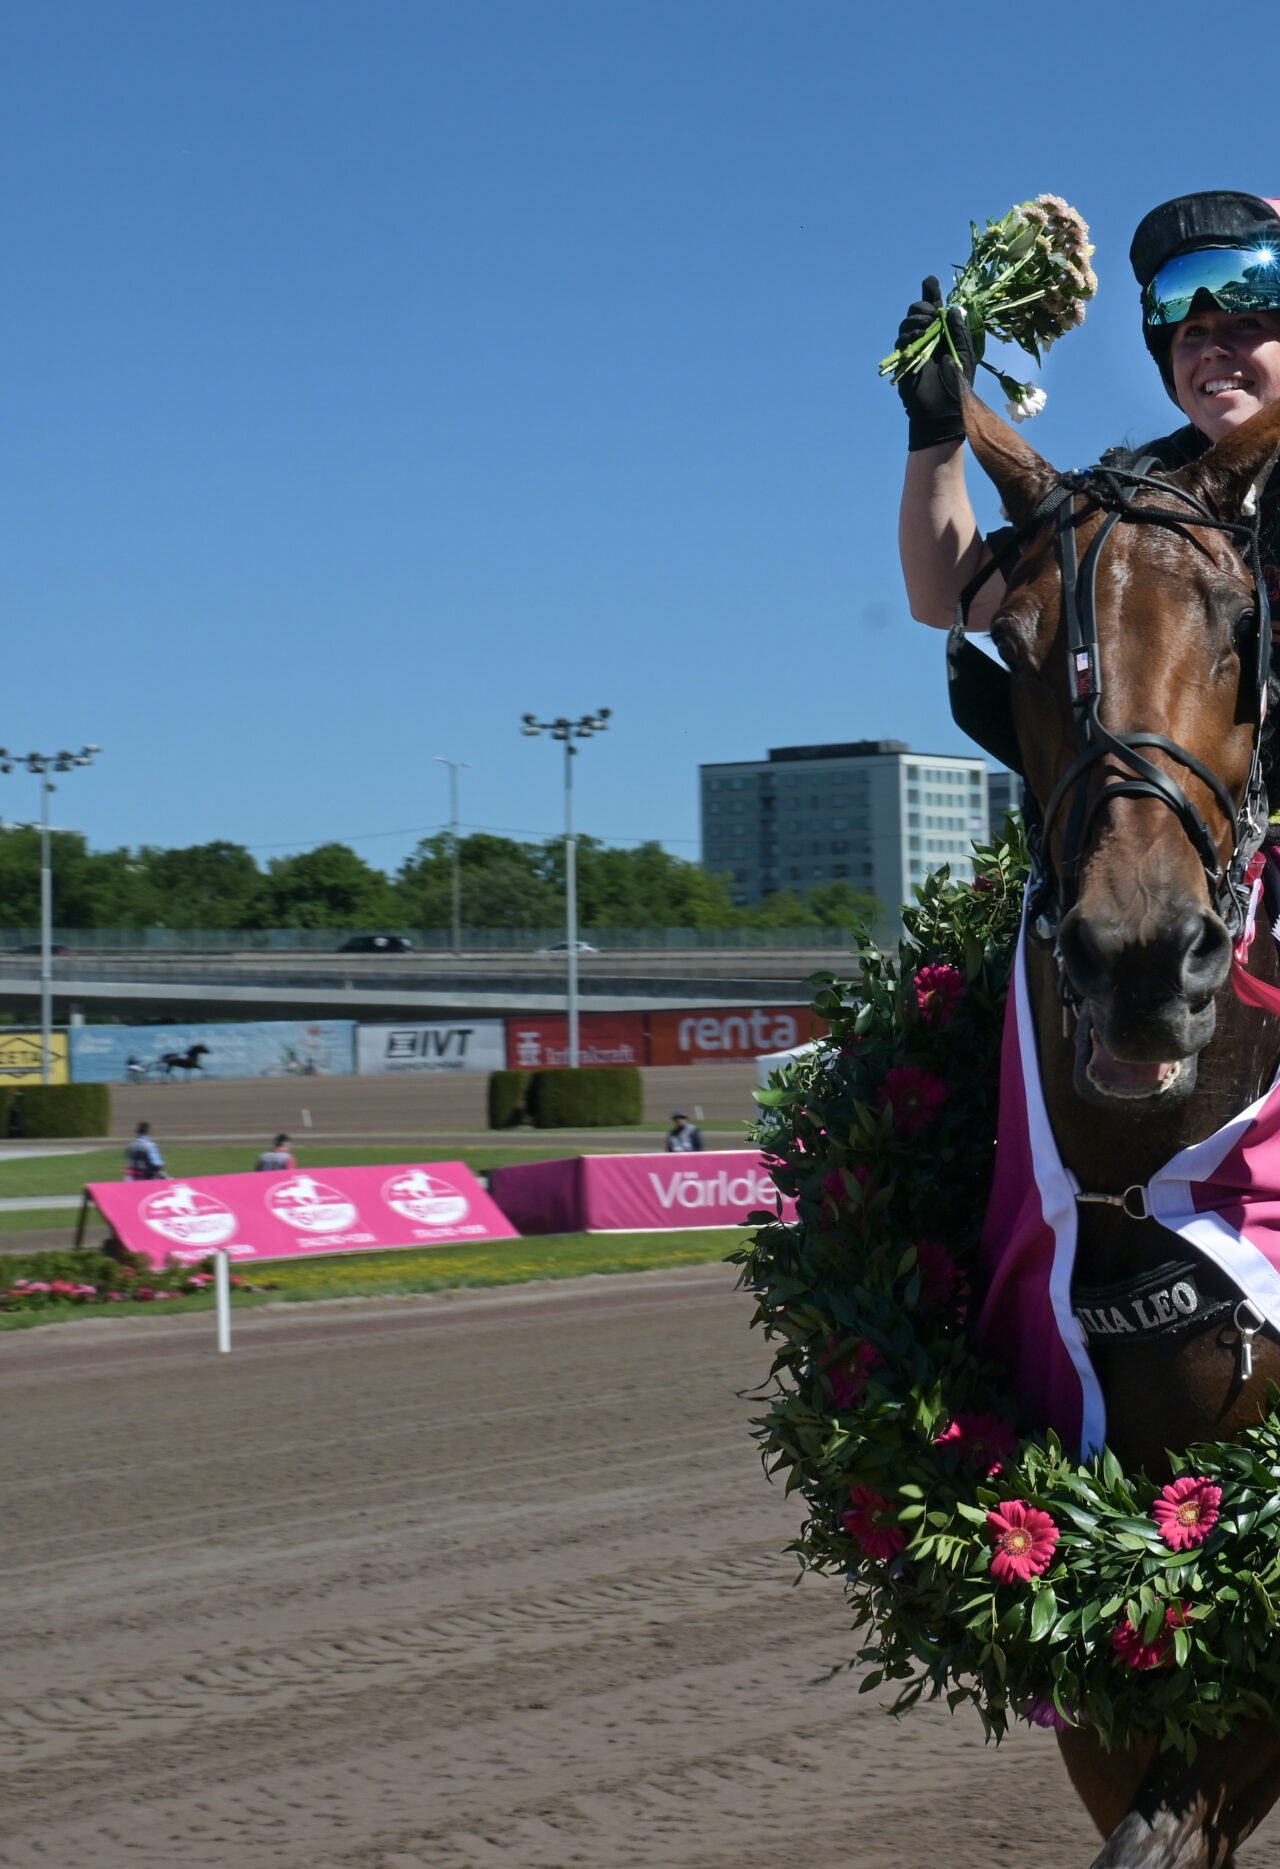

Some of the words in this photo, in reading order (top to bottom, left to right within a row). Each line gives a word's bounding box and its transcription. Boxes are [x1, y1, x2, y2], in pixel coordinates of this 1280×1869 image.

[421, 1029, 474, 1056] IVT
[678, 1009, 798, 1051] renta
[649, 1170, 779, 1208] Världe
[1131, 1281, 1198, 1329] LEO
